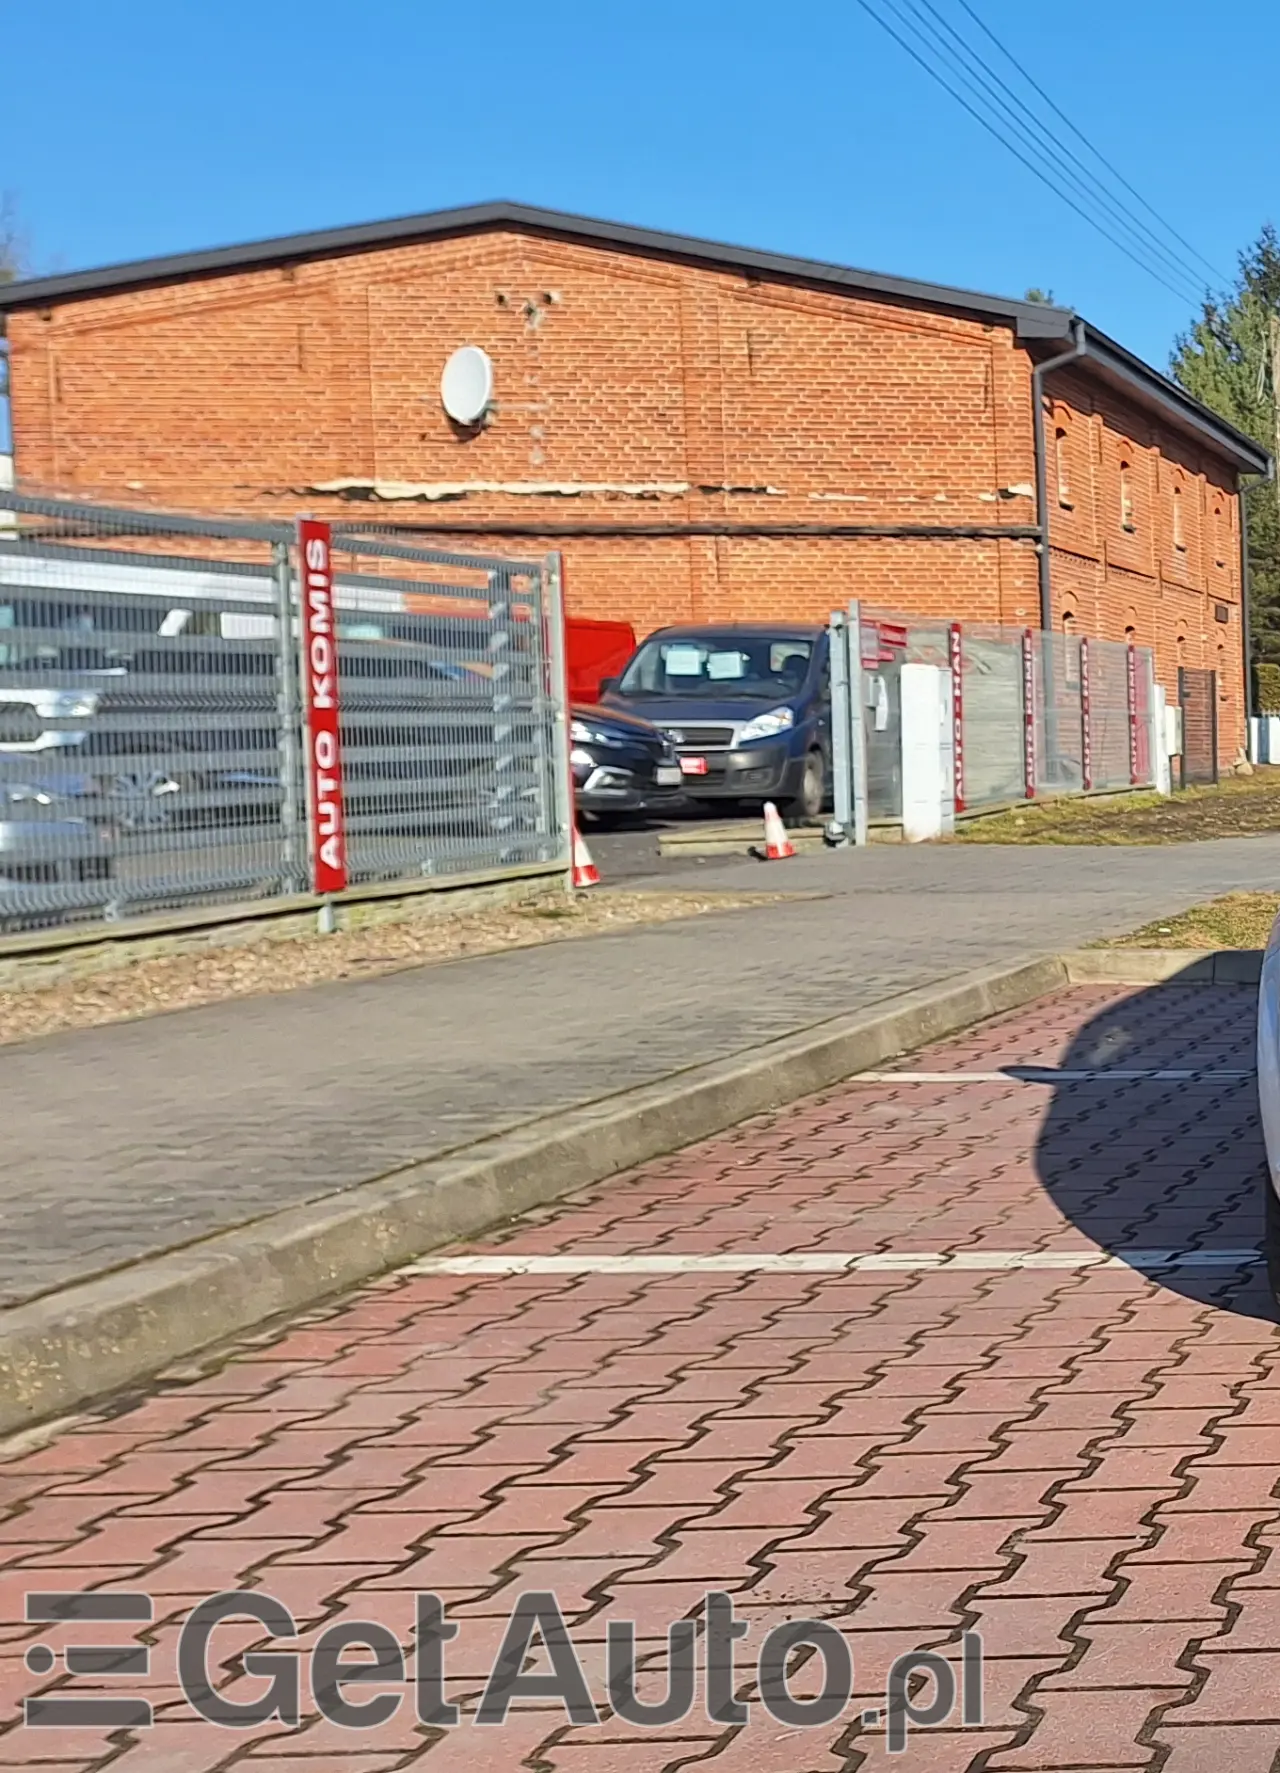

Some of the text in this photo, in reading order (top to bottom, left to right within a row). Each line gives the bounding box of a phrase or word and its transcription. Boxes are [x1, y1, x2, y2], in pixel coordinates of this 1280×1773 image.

[305, 538, 342, 871] AUTO KOMIS
[1024, 637, 1035, 788] AUTO KOMIS
